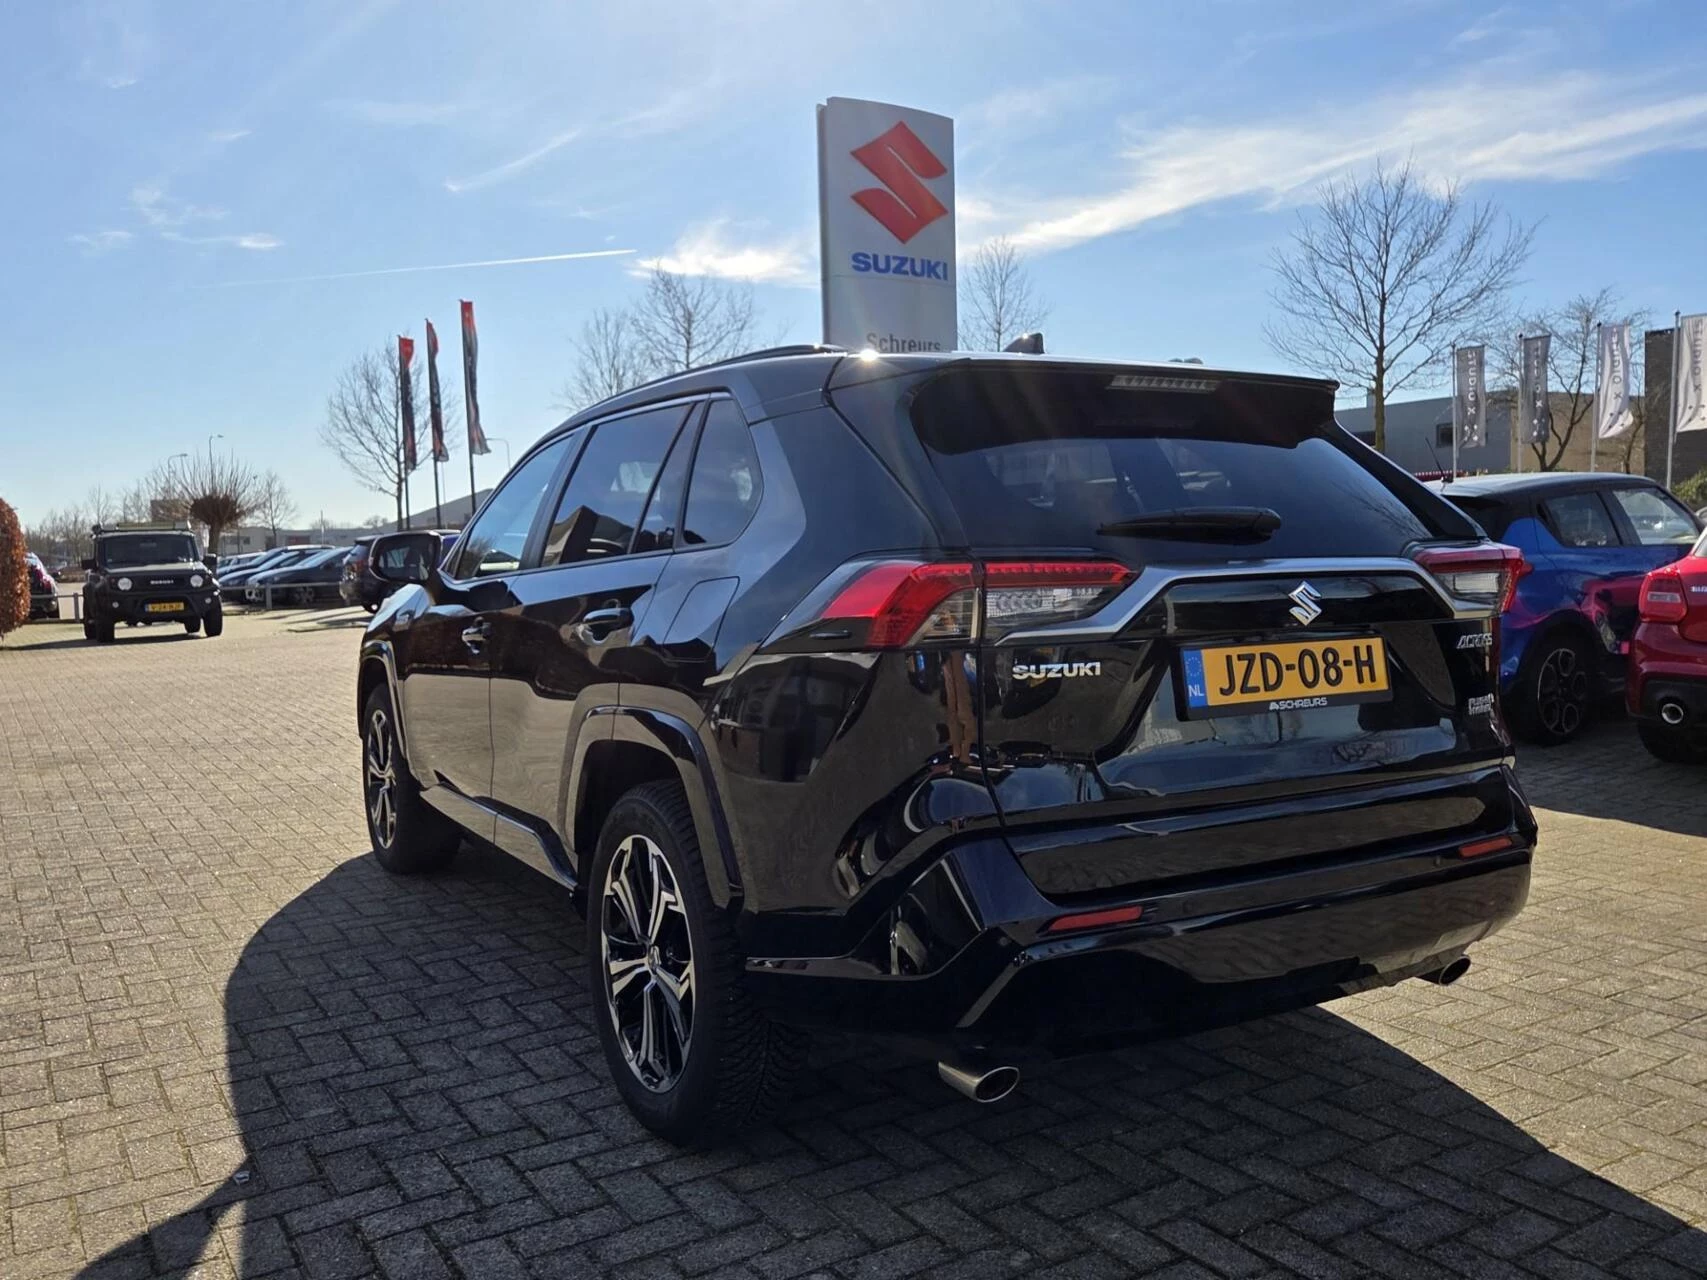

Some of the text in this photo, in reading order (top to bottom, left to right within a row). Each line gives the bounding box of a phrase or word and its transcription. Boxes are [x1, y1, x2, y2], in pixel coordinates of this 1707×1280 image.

[852, 252, 948, 281] SUZUKI
[867, 332, 941, 351] Schreurs
[1693, 383, 1702, 392] X
[1467, 406, 1476, 415] X
[1012, 661, 1101, 680] SUZUKI
[1219, 645, 1376, 696] JZD-08-H
[1188, 684, 1205, 697] NL
[1278, 697, 1328, 709] SCHREURS
